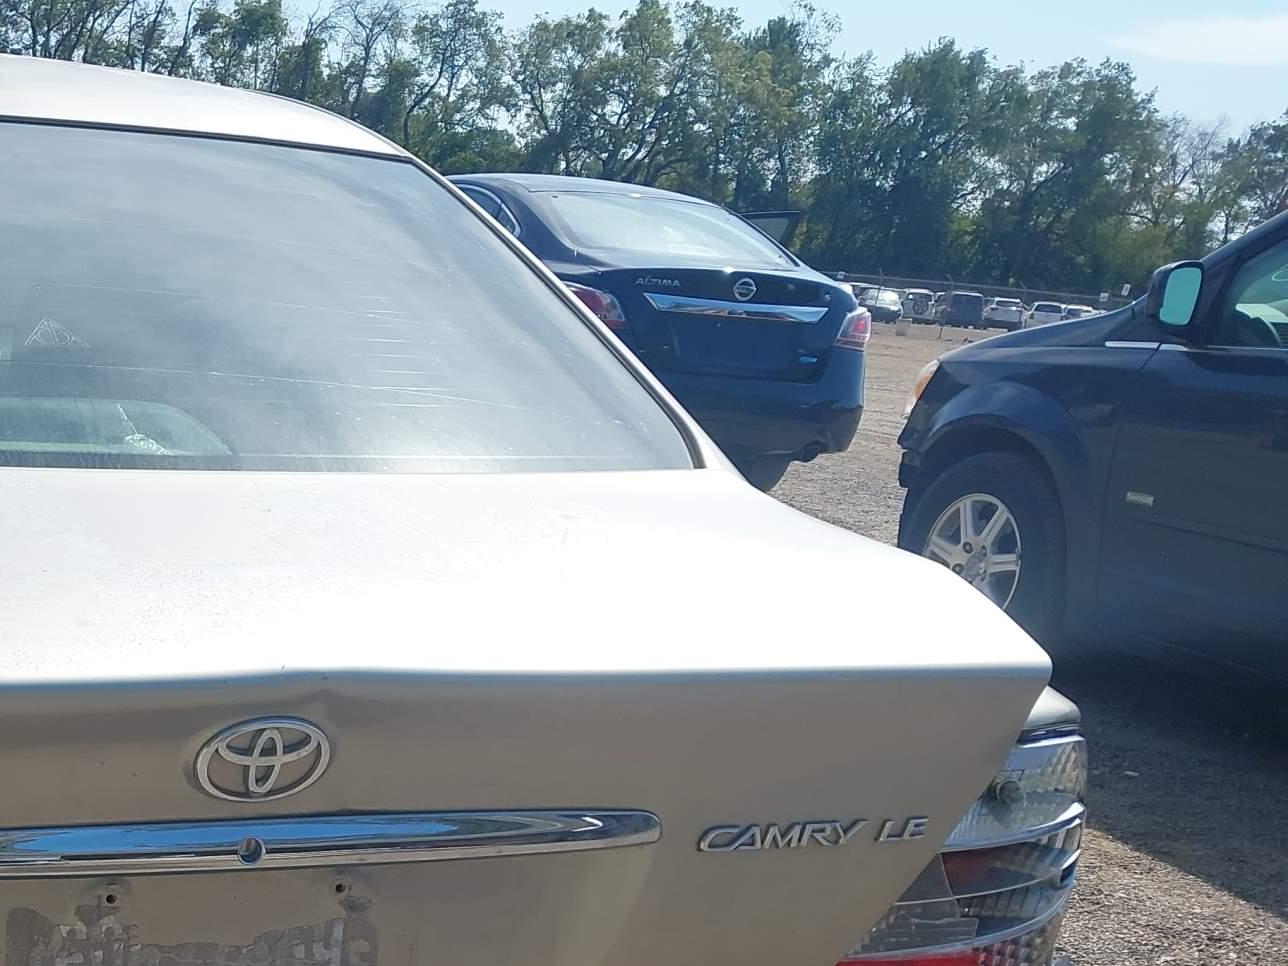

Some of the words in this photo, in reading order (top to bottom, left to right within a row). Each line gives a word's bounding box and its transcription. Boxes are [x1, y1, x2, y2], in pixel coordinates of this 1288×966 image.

[635, 276, 681, 287] ALTIMA
[697, 819, 870, 852] CAMRY
[875, 815, 929, 843] LE
